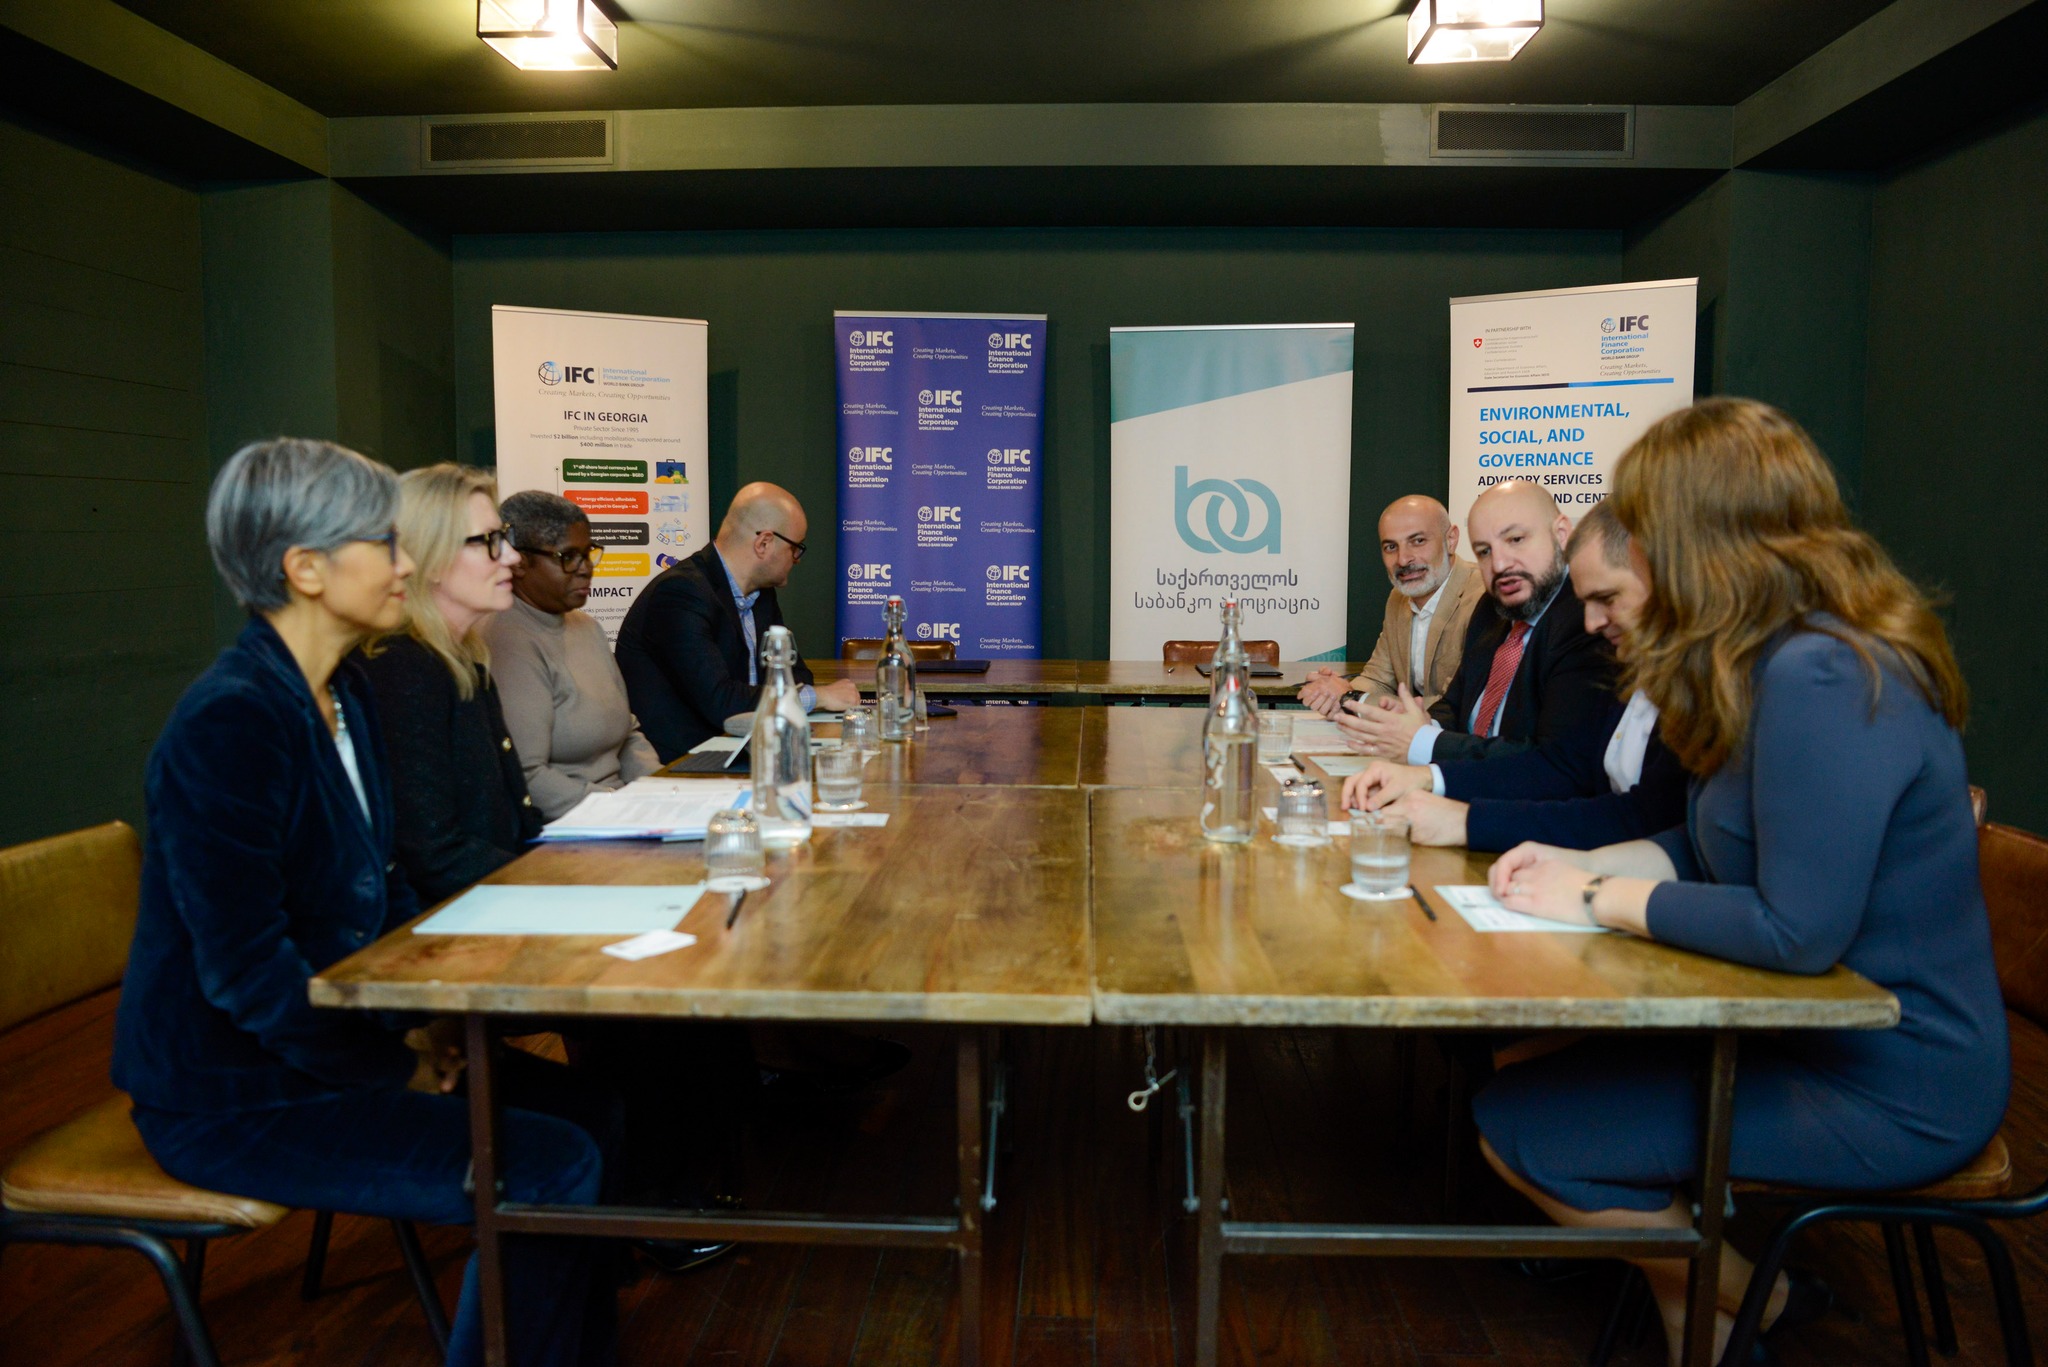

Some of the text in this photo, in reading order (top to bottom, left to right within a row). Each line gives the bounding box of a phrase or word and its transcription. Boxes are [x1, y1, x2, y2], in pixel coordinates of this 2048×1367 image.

[1619, 315, 1649, 332] IFC
[866, 331, 893, 346] IFC
[1005, 334, 1031, 349] IFC
[1601, 333, 1648, 341] International
[1601, 347, 1644, 355] Corporation
[603, 367, 647, 375] International
[1624, 362, 1648, 370] Markets,
[565, 367, 594, 383] IFC
[539, 389, 566, 397] Creating
[599, 391, 625, 400] Creating
[627, 392, 670, 401] Opportunities
[935, 390, 962, 405] IFC
[564, 411, 647, 423] IFC IN GEORGIA
[1480, 403, 1630, 421] ENVIRONMENTAL,
[1480, 428, 1584, 445] SOCIAL, AND
[865, 447, 892, 462] IFC
[1004, 449, 1030, 464] IFC
[1479, 452, 1593, 468] GOVERNANCE
[1544, 474, 1602, 485] SERVICES
[1553, 493, 1609, 503] ND CENT
[934, 506, 961, 522] IFC
[864, 564, 891, 579] IFC
[1003, 566, 1029, 580] IFC
[1157, 568, 1298, 591] საქართველოს
[588, 587, 633, 597] IMPACT
[1135, 592, 1211, 613] საბანკო
[933, 623, 960, 638] IFC
